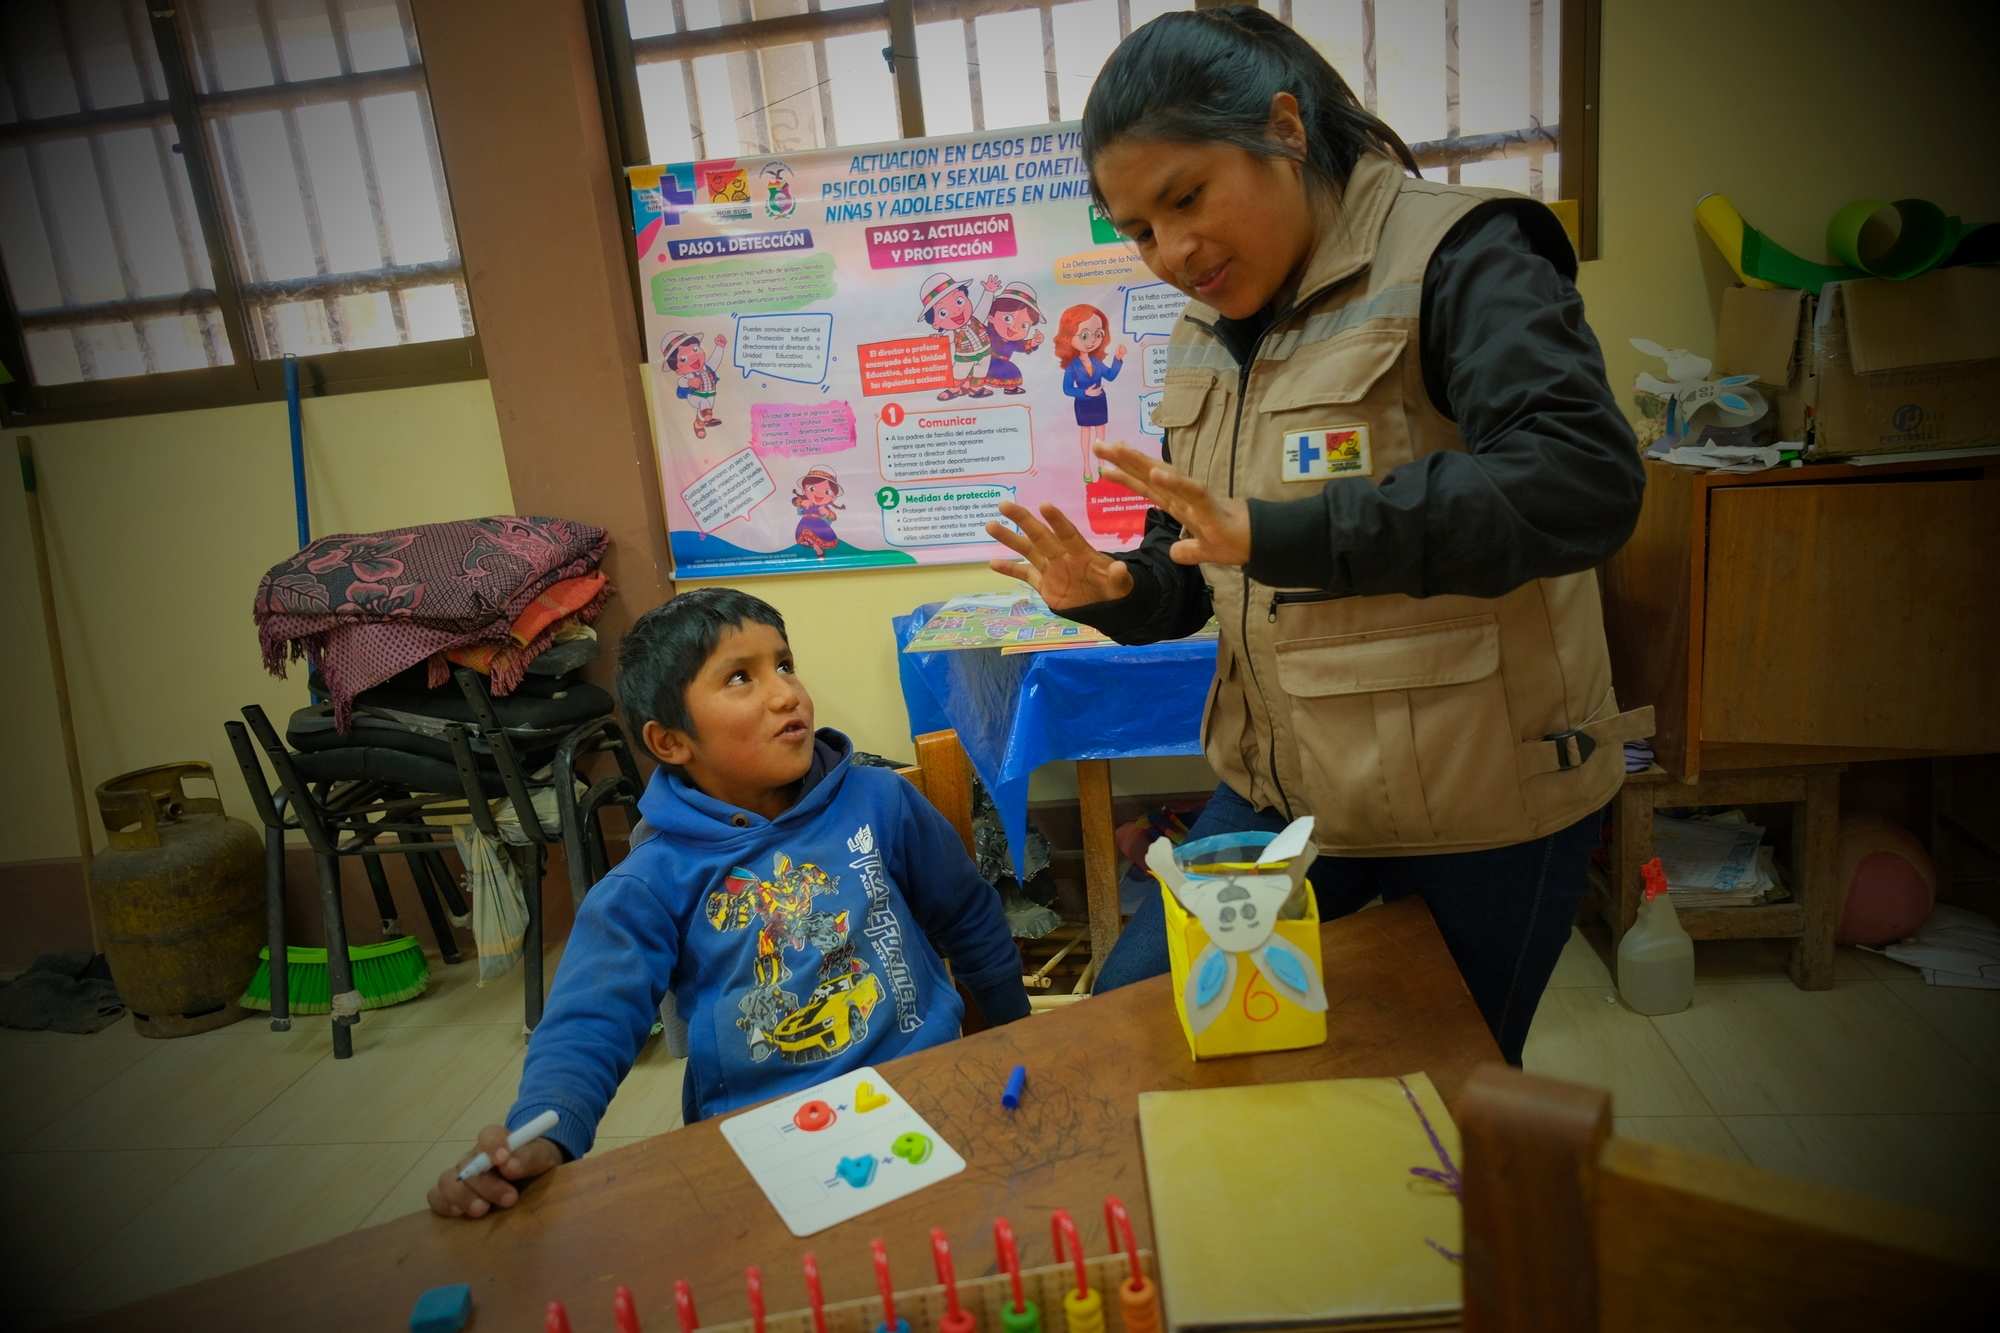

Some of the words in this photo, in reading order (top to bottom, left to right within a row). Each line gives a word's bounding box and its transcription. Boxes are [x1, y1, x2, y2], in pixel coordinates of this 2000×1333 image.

[850, 148, 937, 173] ACTUACION
[945, 144, 966, 163] EN
[972, 139, 1024, 159] CASOS
[1031, 135, 1052, 154] DE
[822, 173, 926, 199] PSICOLOGICA
[932, 171, 942, 185] Y
[947, 165, 1009, 186] SEXUAL
[825, 200, 872, 223] NIÑAS
[878, 201, 887, 216] Y
[891, 188, 1016, 215] ADOLESCENTES
[1022, 185, 1043, 202] EN
[1049, 179, 1091, 199] UNID
[679, 242, 713, 257] PASO
[716, 242, 725, 253] 1.
[729, 231, 804, 252] DETECCIÓN
[873, 229, 910, 245] PASO
[913, 229, 924, 241] 2.
[928, 217, 1009, 240] ACTUACIÓN
[891, 249, 901, 262] Y
[904, 240, 993, 261] PROTECCIÓN
[888, 407, 896, 423] 1
[918, 416, 977, 428] Comunicar
[906, 433, 924, 442] padres
[882, 491, 895, 507] 2
[905, 494, 942, 503] Medidas
[944, 492, 955, 501] de
[957, 490, 1001, 502] protección
[859, 873, 873, 899] AGE
[850, 849, 925, 1033] TRANSFORMERS
[1243, 970, 1279, 1022] 6
